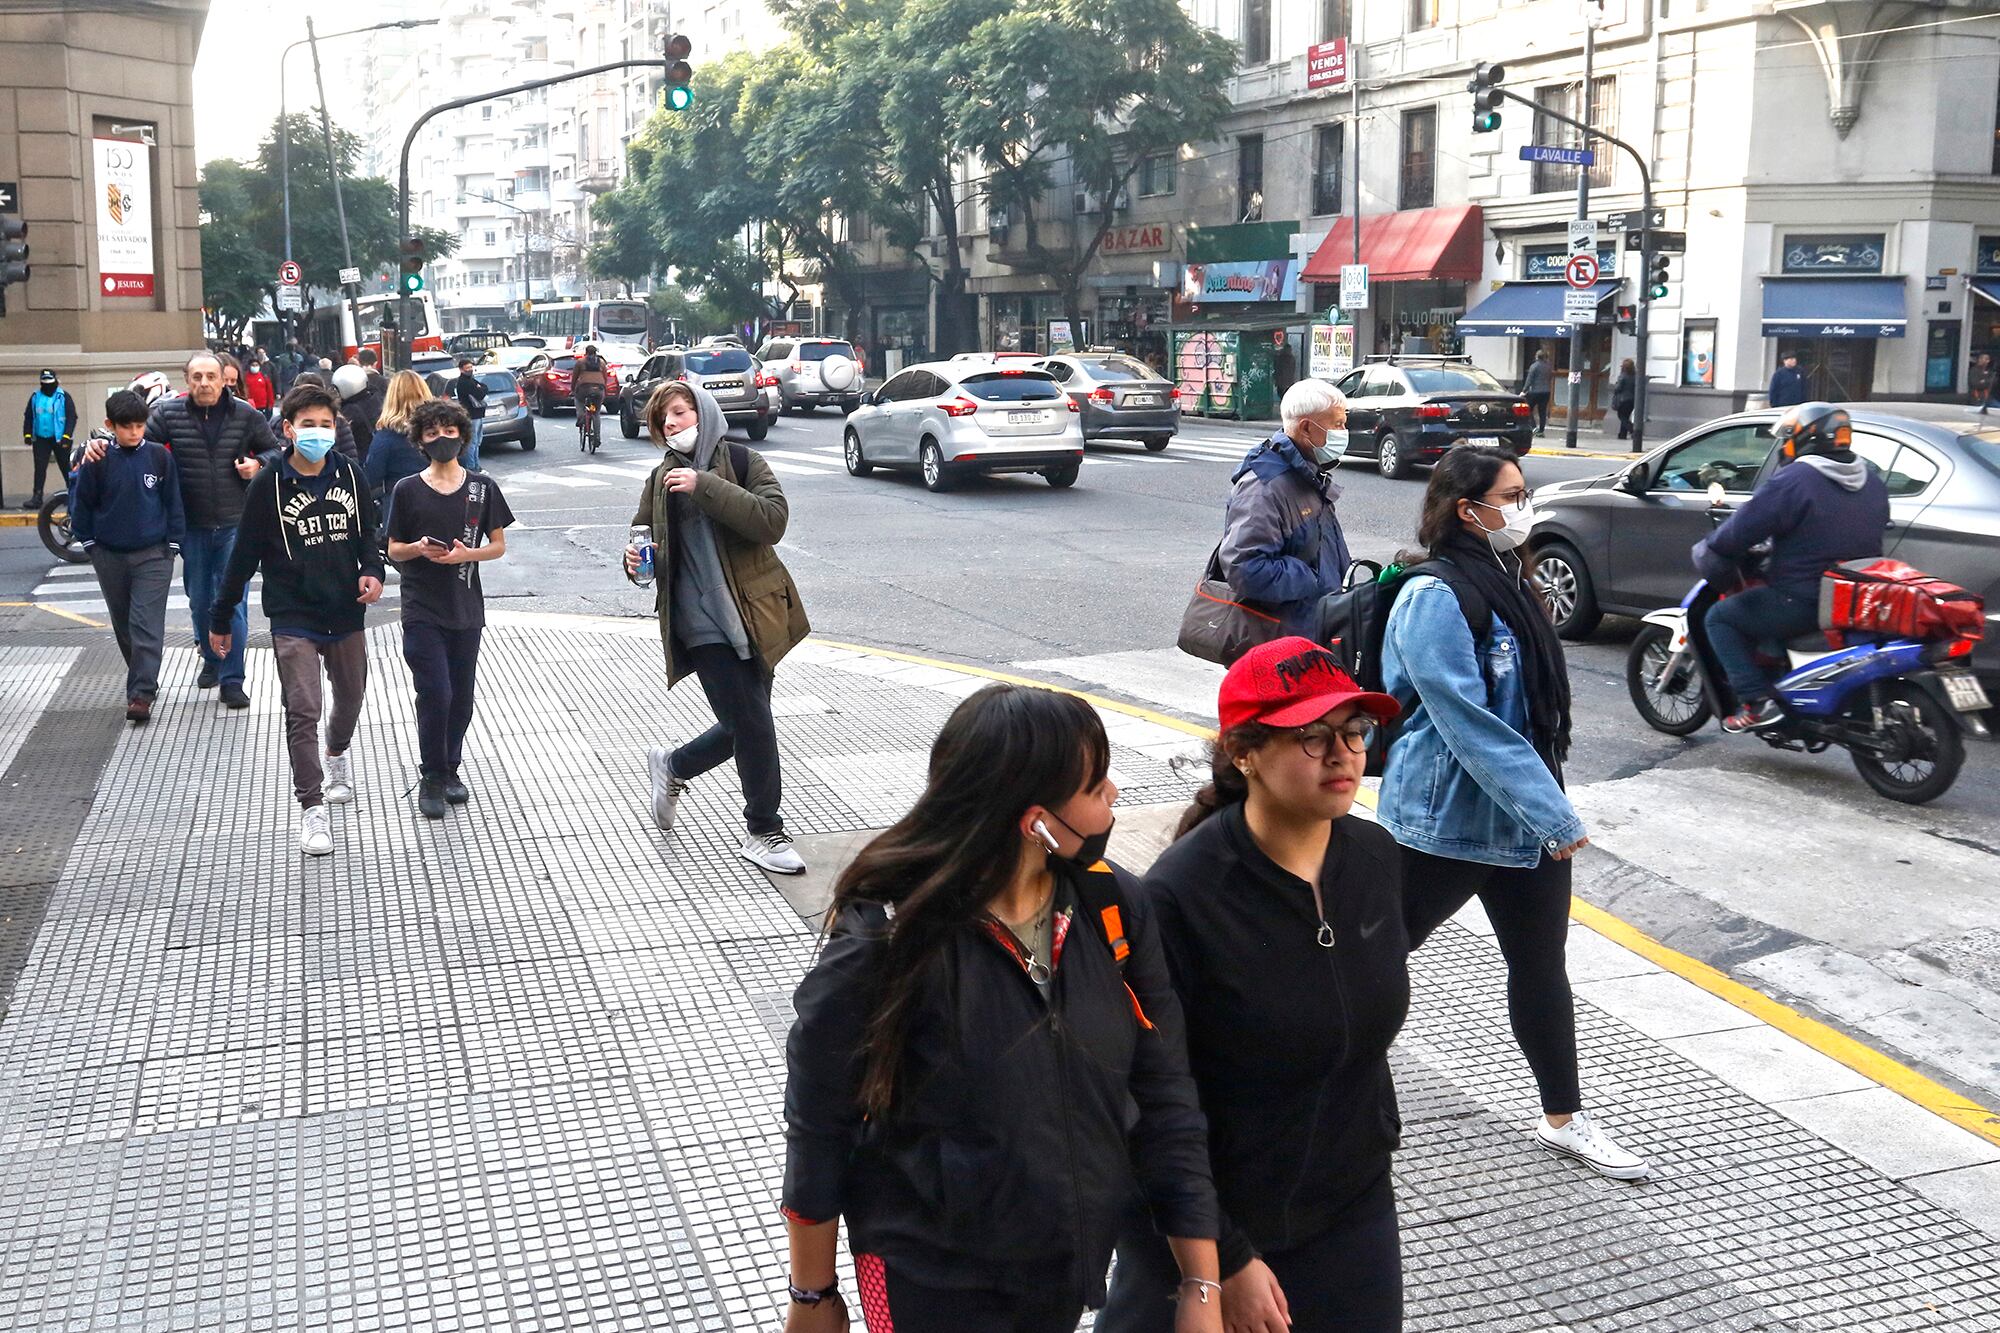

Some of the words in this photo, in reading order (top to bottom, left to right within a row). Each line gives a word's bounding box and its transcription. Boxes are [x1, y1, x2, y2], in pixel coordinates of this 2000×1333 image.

[1311, 54, 1344, 70] VENDE
[1534, 148, 1582, 163] LAVALLE
[112, 234, 148, 244] SALVADOR
[1104, 226, 1164, 250] BAZAR
[117, 280, 145, 290] JESUITAS
[1314, 332, 1331, 344] COMA
[1335, 332, 1353, 344] COMA
[1314, 344, 1331, 356] SANO
[1335, 345, 1352, 357] SANO
[304, 535, 324, 547] NEW
[329, 532, 348, 541] YORK
